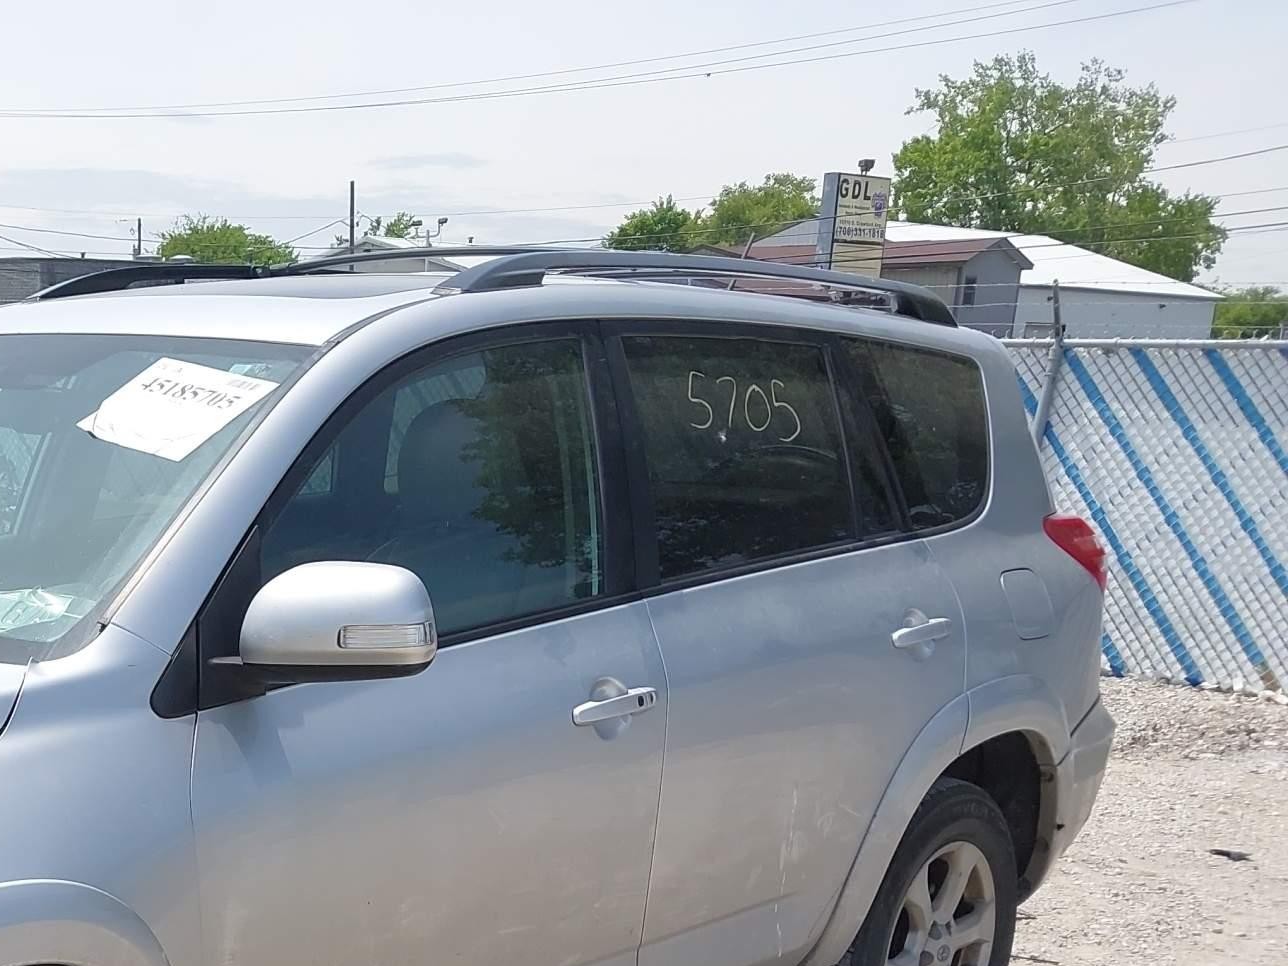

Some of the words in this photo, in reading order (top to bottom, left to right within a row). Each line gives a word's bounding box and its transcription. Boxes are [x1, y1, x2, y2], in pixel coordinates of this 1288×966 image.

[839, 178, 871, 201] GDL
[141, 377, 243, 410] 45185705
[688, 371, 801, 442] 5705
